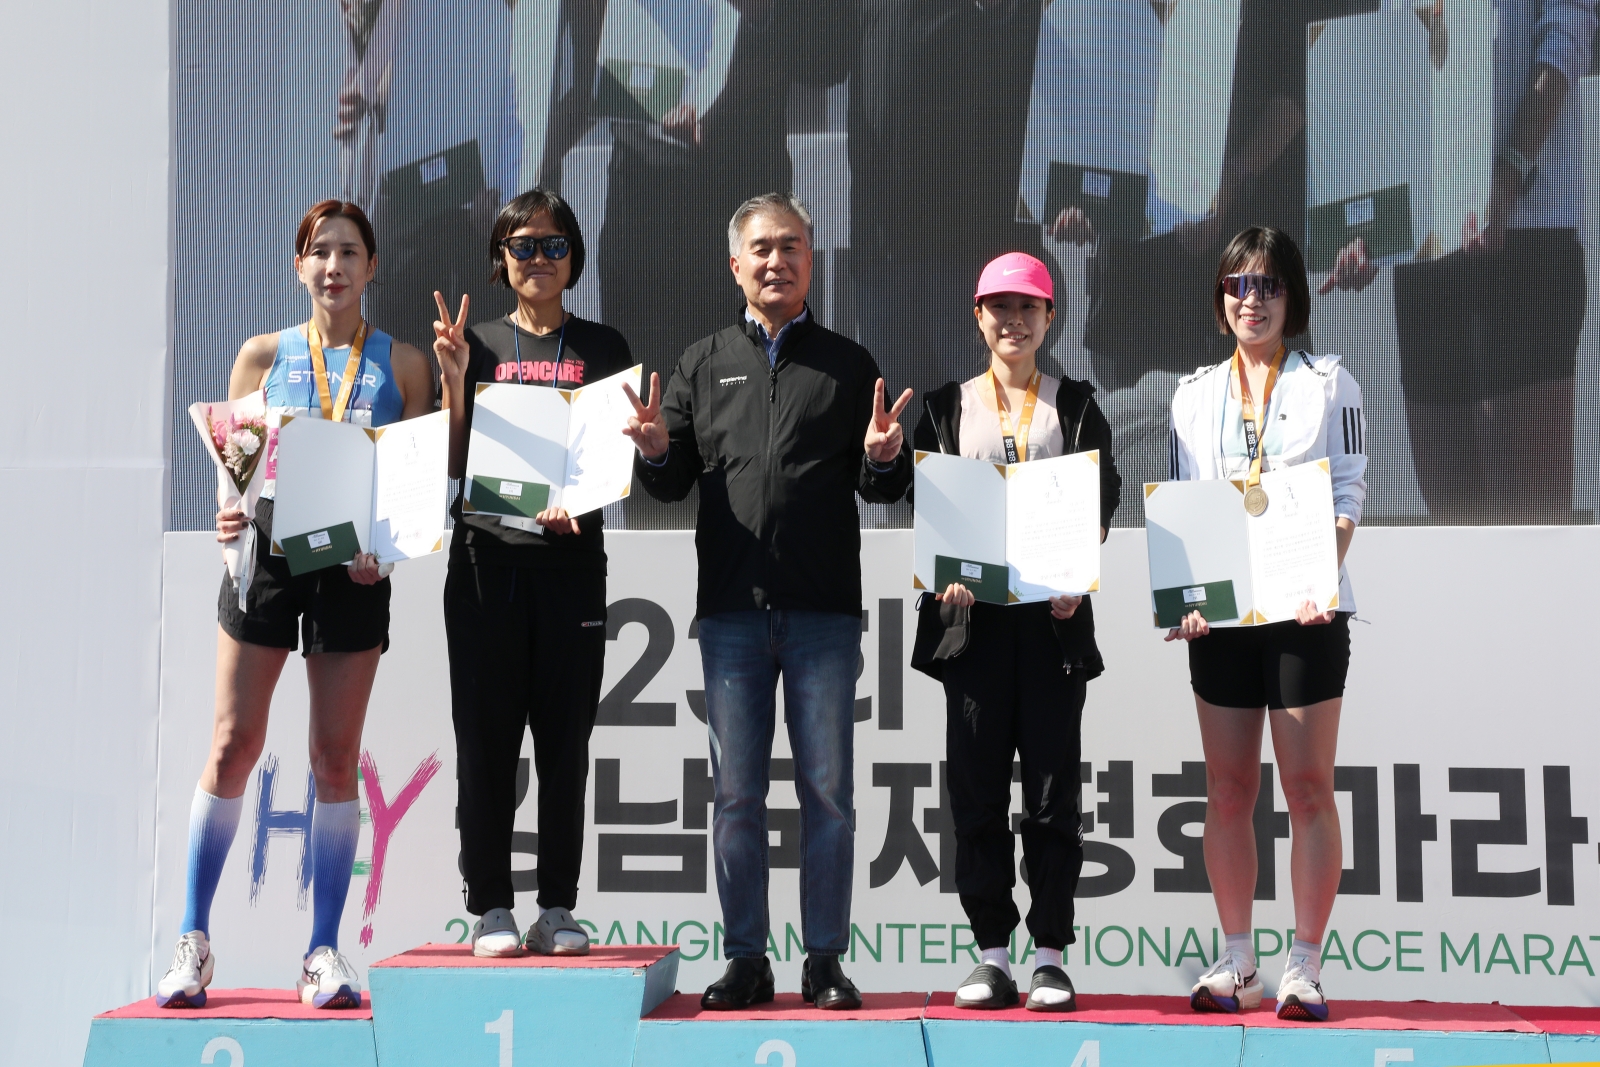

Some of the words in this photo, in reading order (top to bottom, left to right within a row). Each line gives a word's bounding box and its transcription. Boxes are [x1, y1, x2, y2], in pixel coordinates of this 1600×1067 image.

[287, 371, 377, 388] STNR
[495, 361, 584, 385] OPENCARE
[1254, 928, 1424, 972] PACE
[484, 1009, 514, 1067] 1
